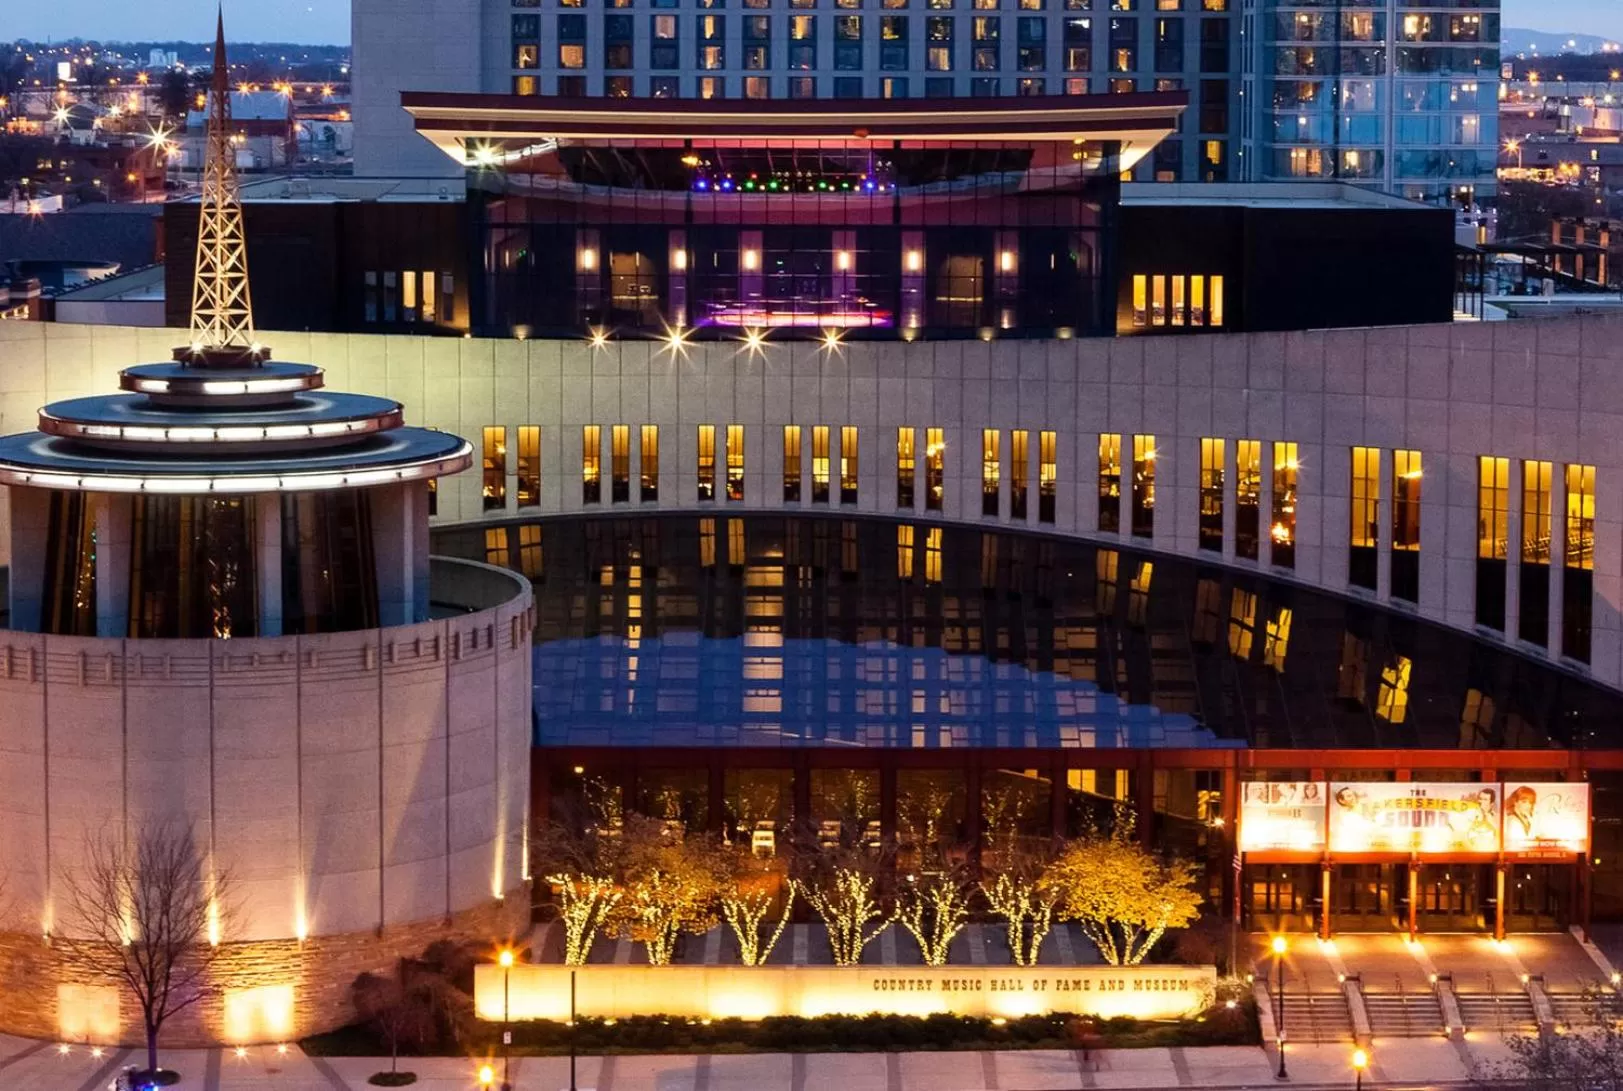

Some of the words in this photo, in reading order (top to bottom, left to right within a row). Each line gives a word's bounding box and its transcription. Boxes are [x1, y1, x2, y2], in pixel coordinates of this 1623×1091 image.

[1410, 789, 1427, 797] THE
[873, 979, 933, 991] COUNTRY
[941, 979, 982, 991] MUSIC
[990, 979, 1024, 991] HALL
[1032, 979, 1048, 991] OF
[1055, 979, 1091, 991] FAME
[1098, 979, 1126, 991] AND
[1133, 979, 1189, 991] MUSEUM
